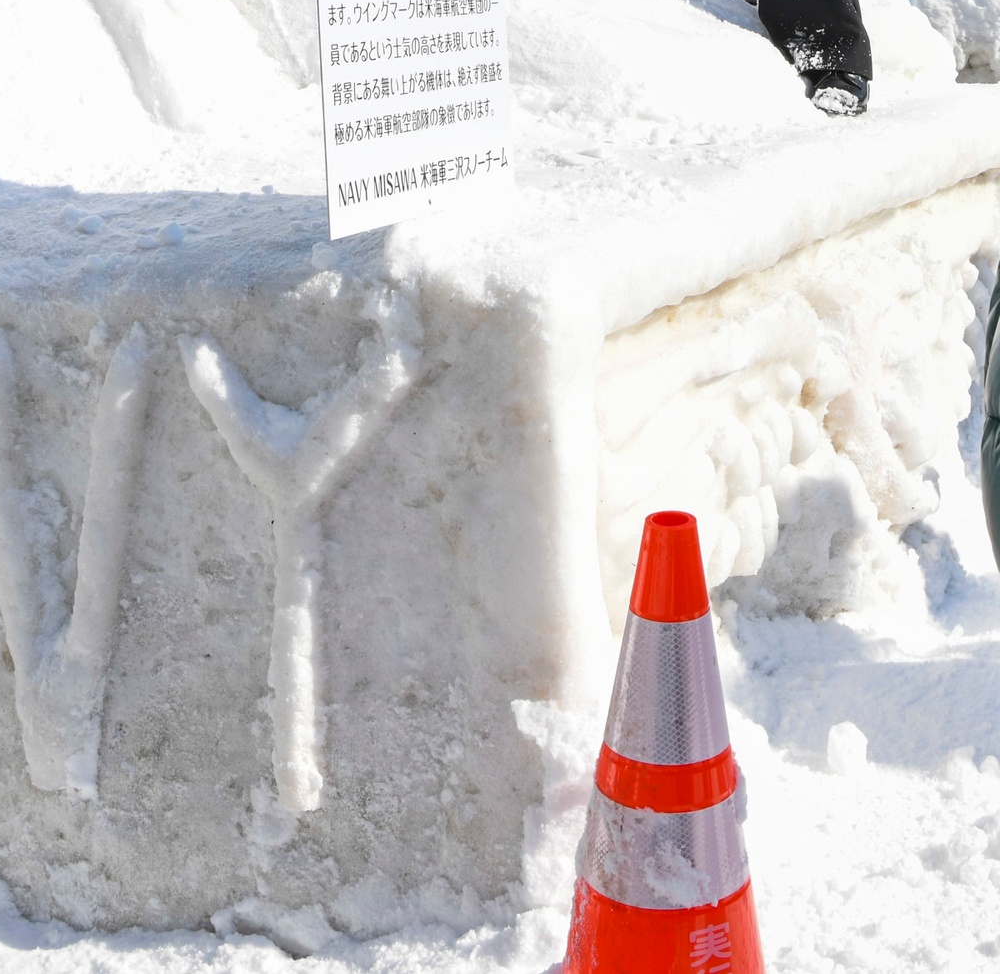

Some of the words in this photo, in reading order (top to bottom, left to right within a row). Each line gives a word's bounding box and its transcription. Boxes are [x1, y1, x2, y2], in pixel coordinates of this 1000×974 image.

[330, 28, 500, 67] 員であるという士気の高さを表現しています。
[332, 62, 504, 106] 背景にある舞い上がる機体は、絶えず隆盛を
[334, 98, 495, 146] 極める米海軍航空部隊の象徴であります。
[338, 177, 371, 208] NAVY
[373, 167, 419, 199] MISAWA
[420, 147, 509, 189] 米海軍三沢スノーチーム
[689, 921, 732, 974] 実
